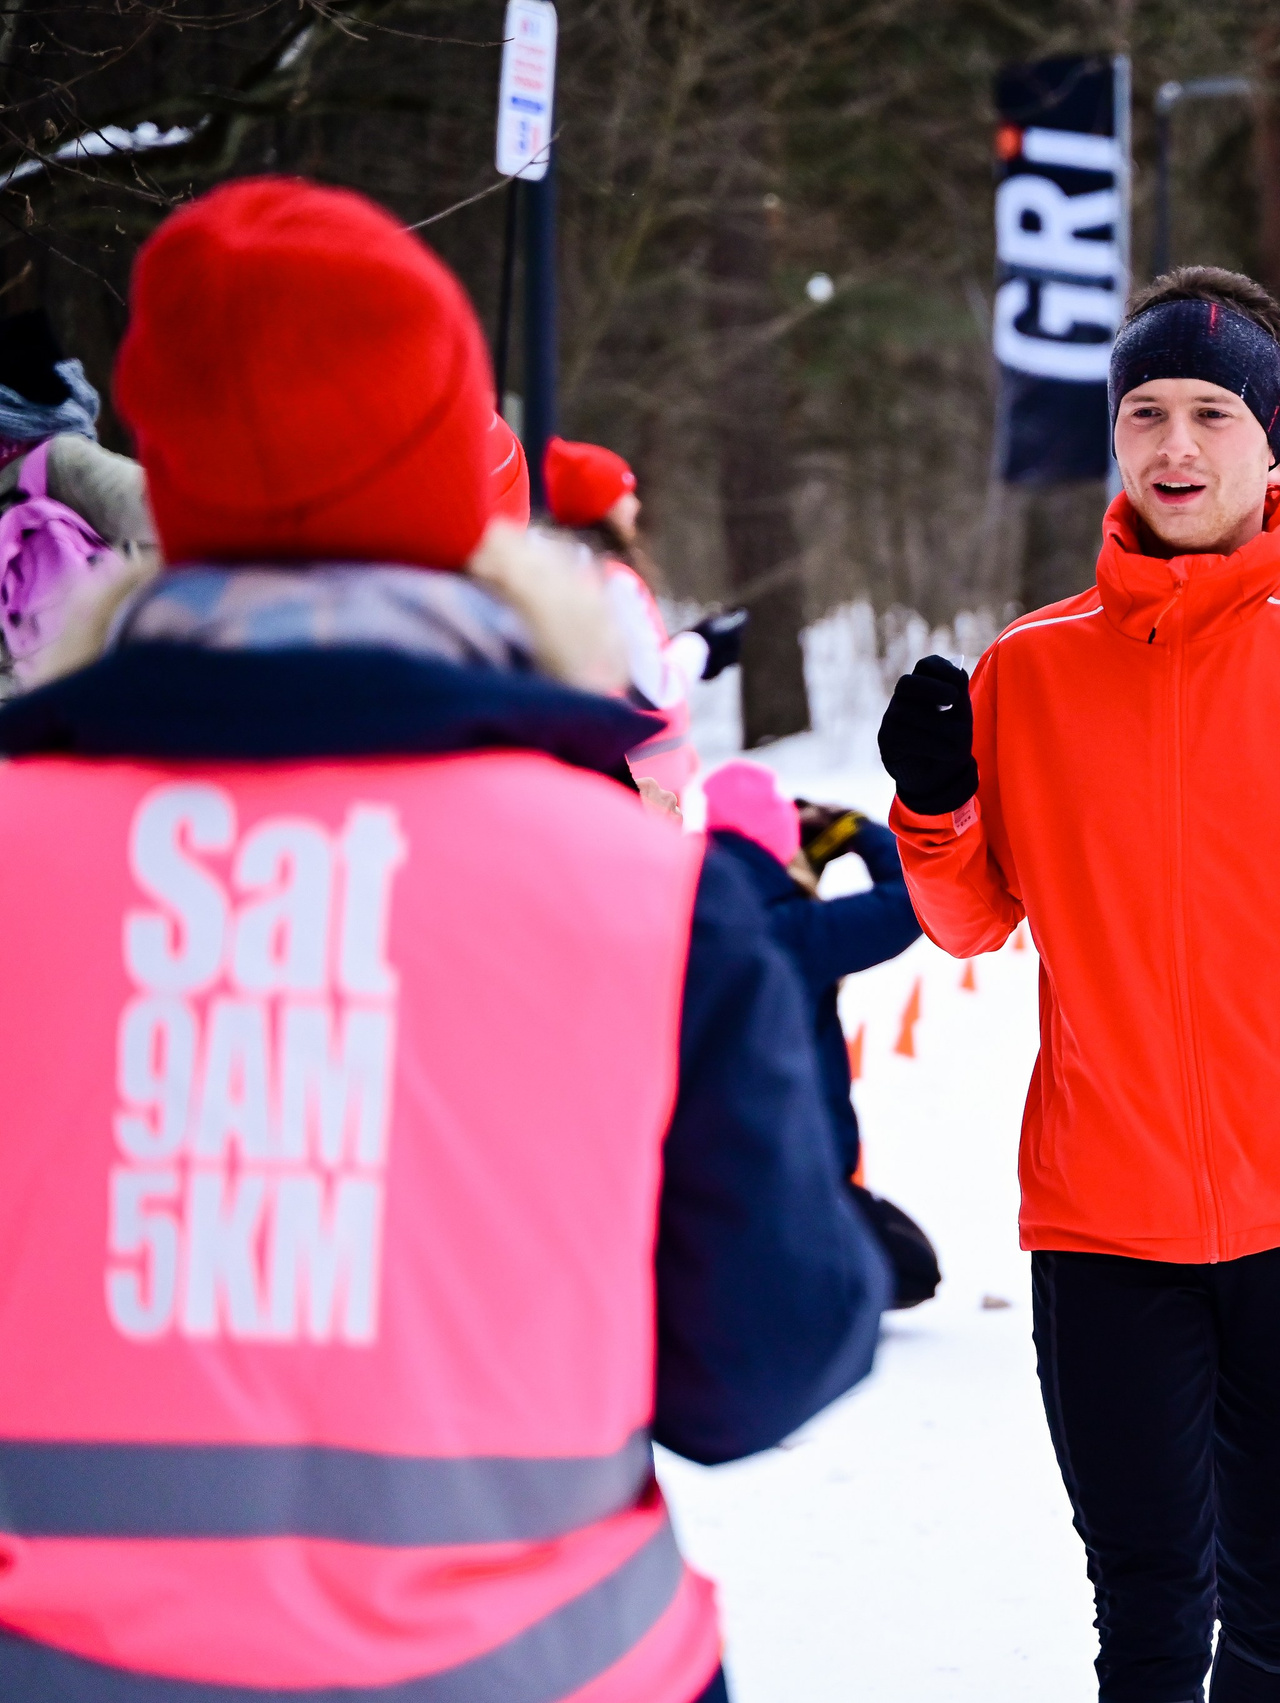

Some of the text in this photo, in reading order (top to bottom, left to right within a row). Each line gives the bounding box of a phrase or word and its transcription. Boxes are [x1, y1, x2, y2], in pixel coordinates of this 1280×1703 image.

[122, 783, 406, 996] Sat
[115, 996, 396, 1164] 9AM
[106, 1165, 382, 1343] 5KM
